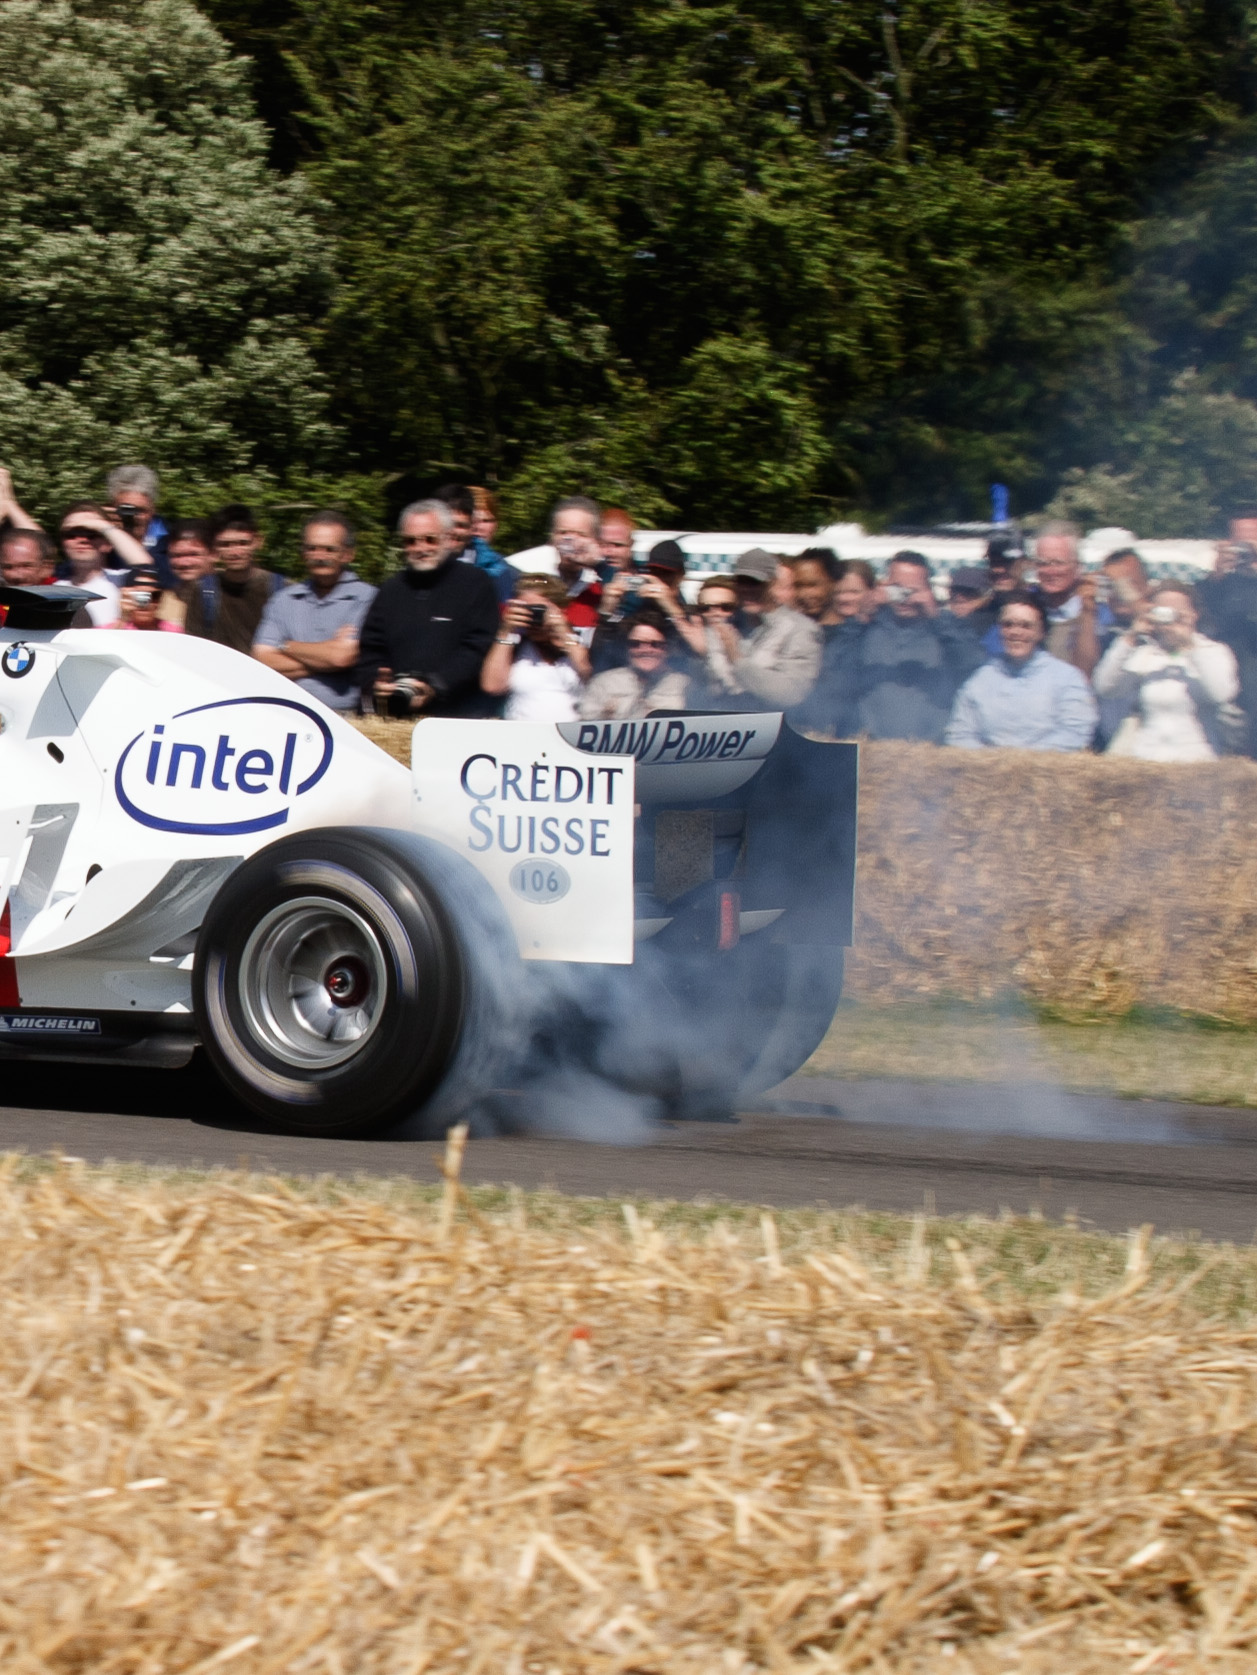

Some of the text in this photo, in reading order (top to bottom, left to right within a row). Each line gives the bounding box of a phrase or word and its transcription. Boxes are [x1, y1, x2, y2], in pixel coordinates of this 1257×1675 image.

[145, 723, 297, 796] intel
[576, 720, 757, 762] BMW Power
[467, 804, 611, 857] SUISSE
[520, 869, 559, 892] 106
[11, 1017, 96, 1031] MICHELIN
